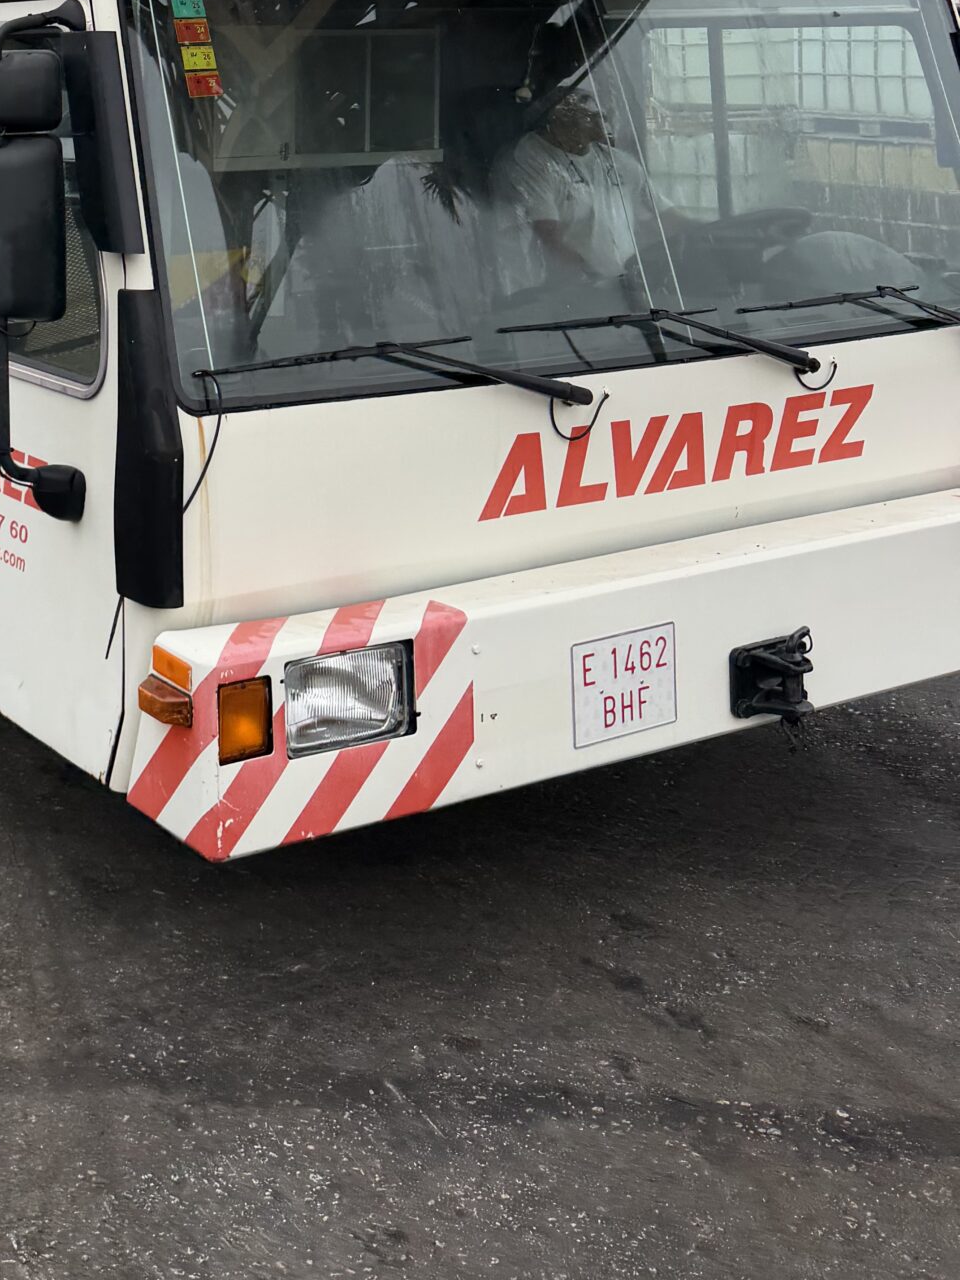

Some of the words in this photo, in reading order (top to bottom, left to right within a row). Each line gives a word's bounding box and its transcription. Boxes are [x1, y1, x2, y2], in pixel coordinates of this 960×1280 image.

[478, 384, 874, 522] ALVAREZ
[9, 520, 29, 543] 60
[582, 653, 596, 687] E
[610, 635, 668, 679] 1462
[602, 685, 651, 729] BHF
